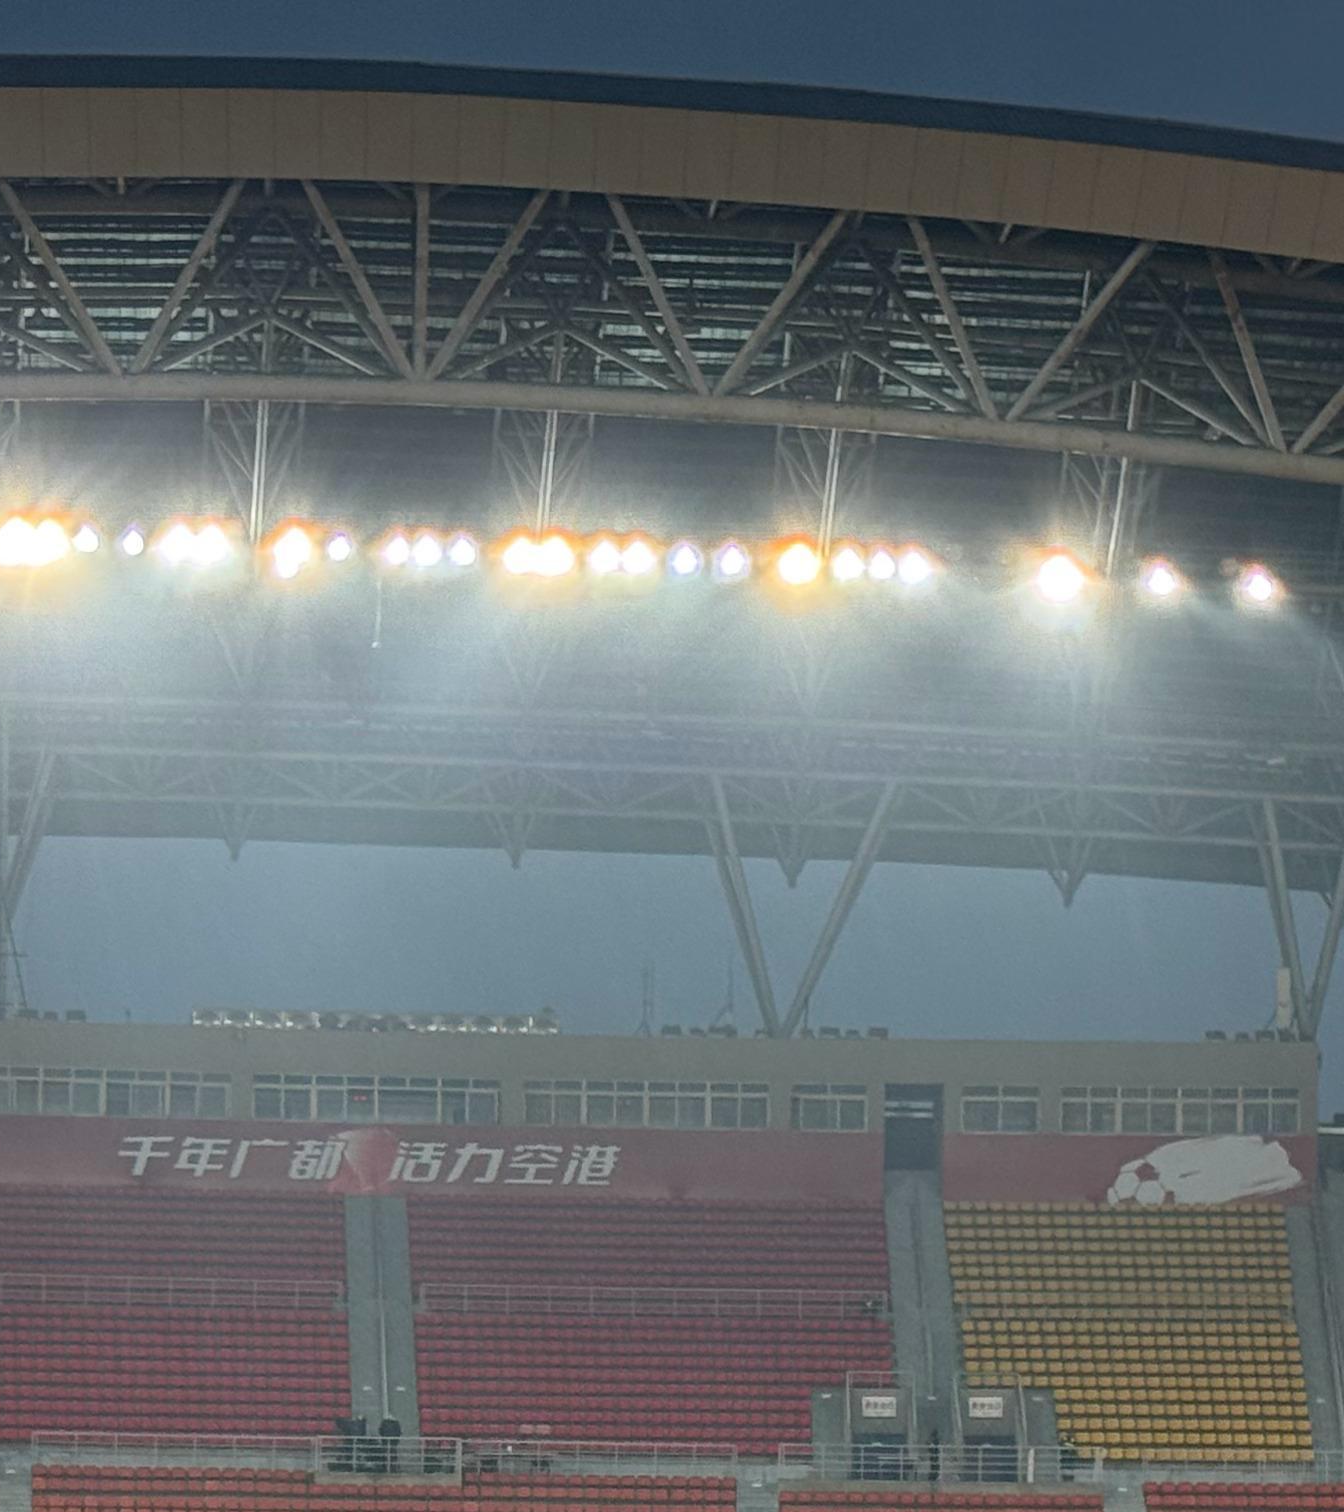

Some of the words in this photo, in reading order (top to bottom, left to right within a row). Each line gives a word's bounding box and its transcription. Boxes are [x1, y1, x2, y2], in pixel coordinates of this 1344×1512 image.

[117, 1135, 346, 1180] 千年广都
[391, 1141, 622, 1187] 活力空港
